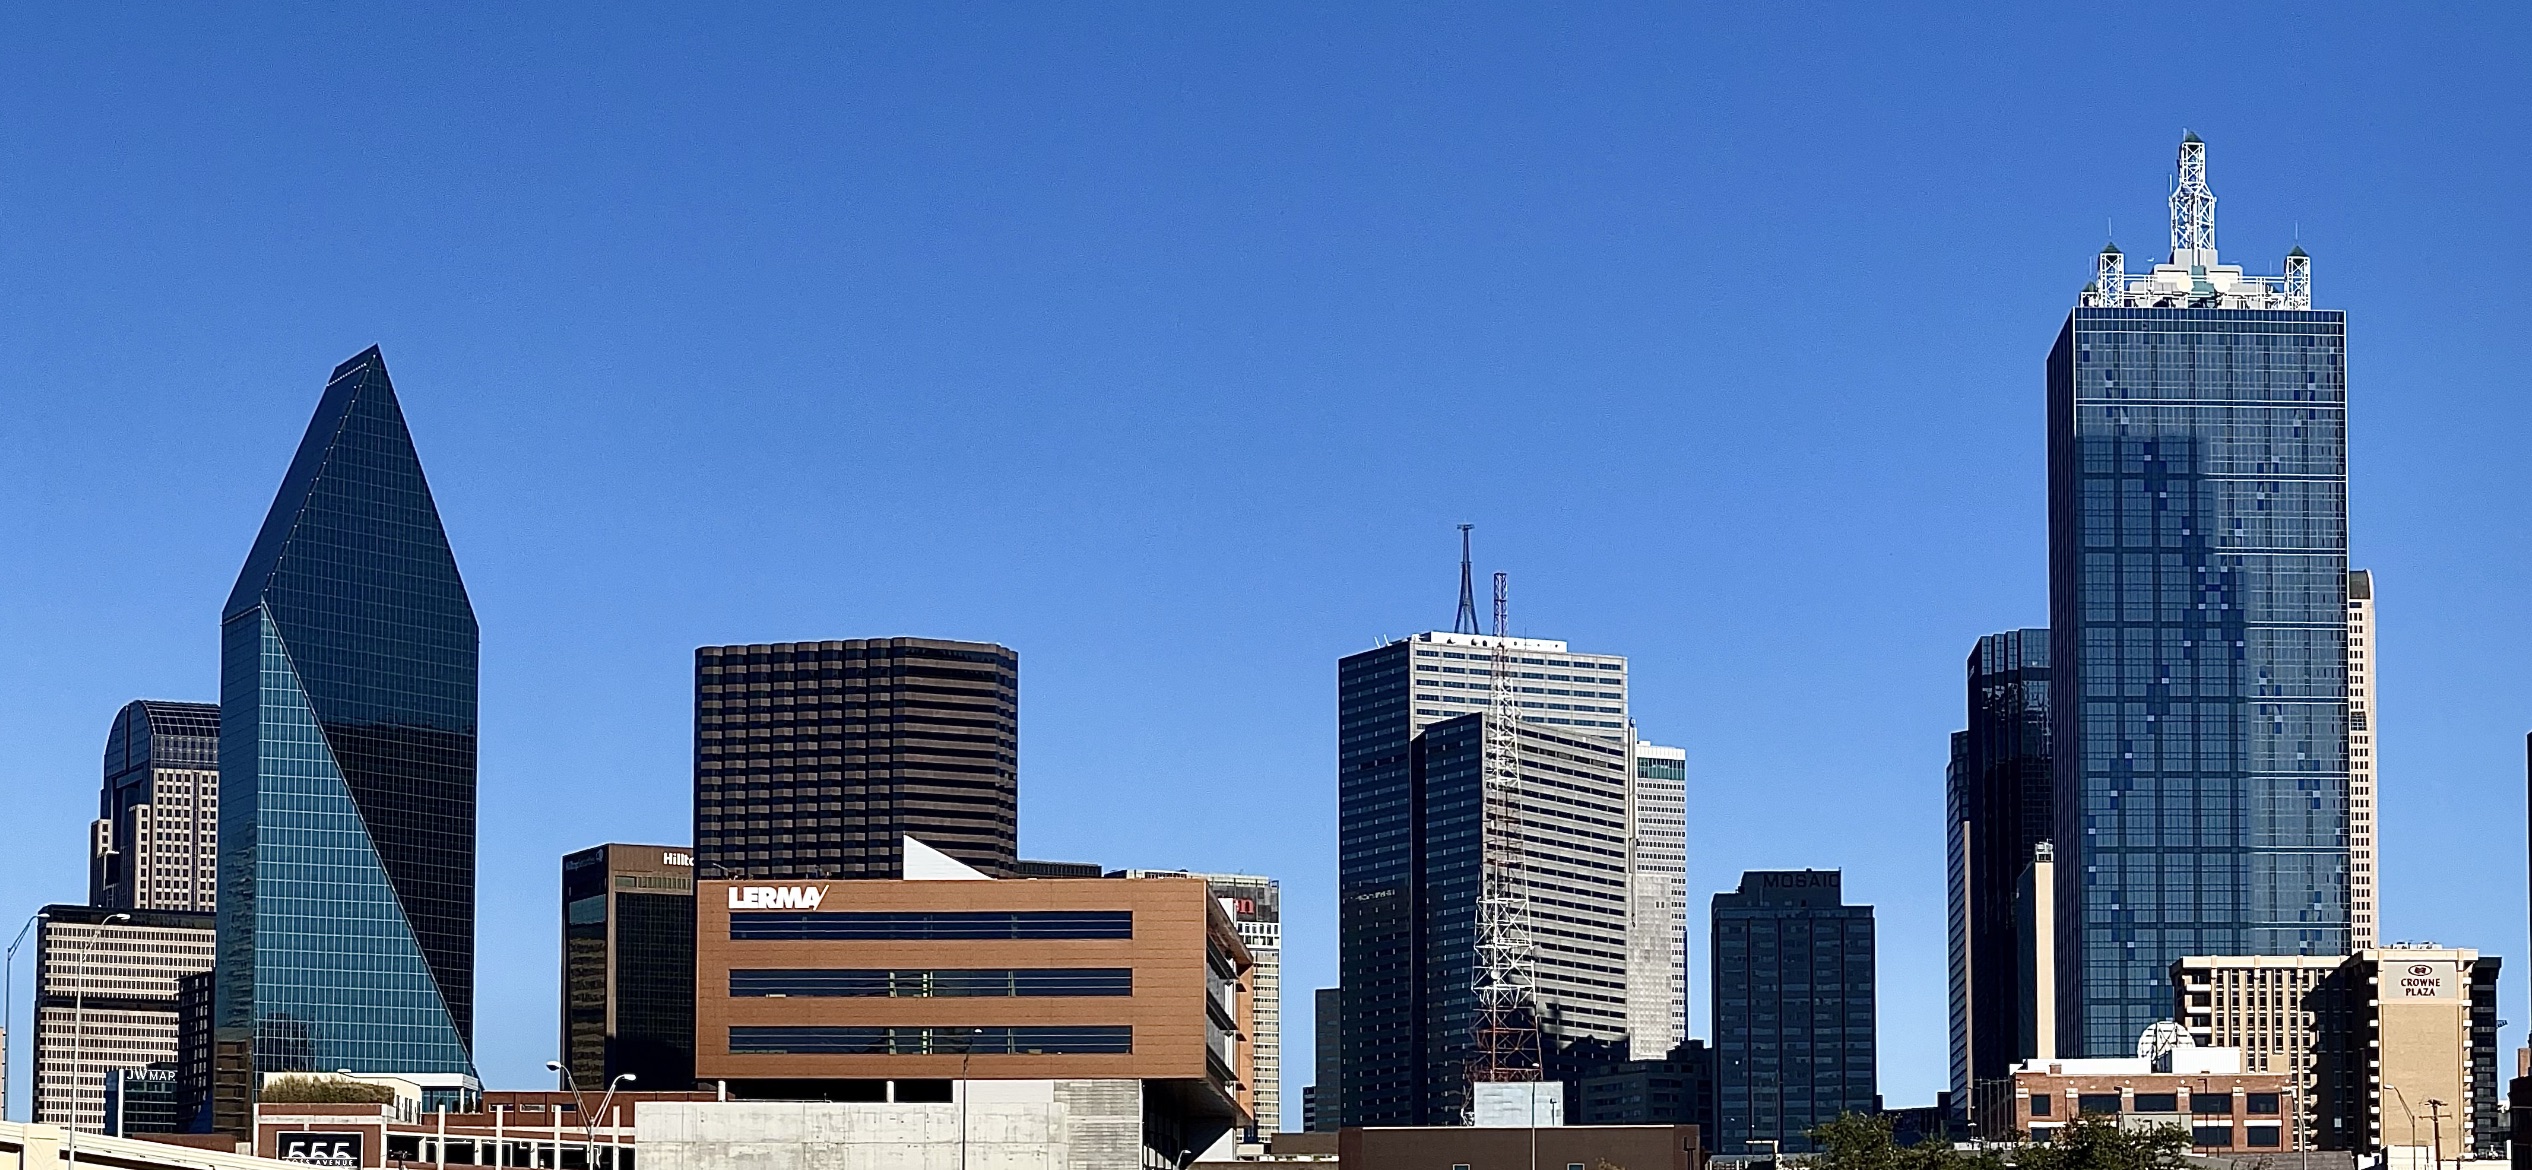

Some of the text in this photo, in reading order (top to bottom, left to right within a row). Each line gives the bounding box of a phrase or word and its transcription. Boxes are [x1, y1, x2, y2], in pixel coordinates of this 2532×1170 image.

[1763, 873, 1840, 888] MOSAIC
[2400, 978, 2441, 987] CROWNE
[2405, 987, 2436, 997] PLAZA
[126, 1069, 148, 1080] JW
[288, 1141, 351, 1159] 555
